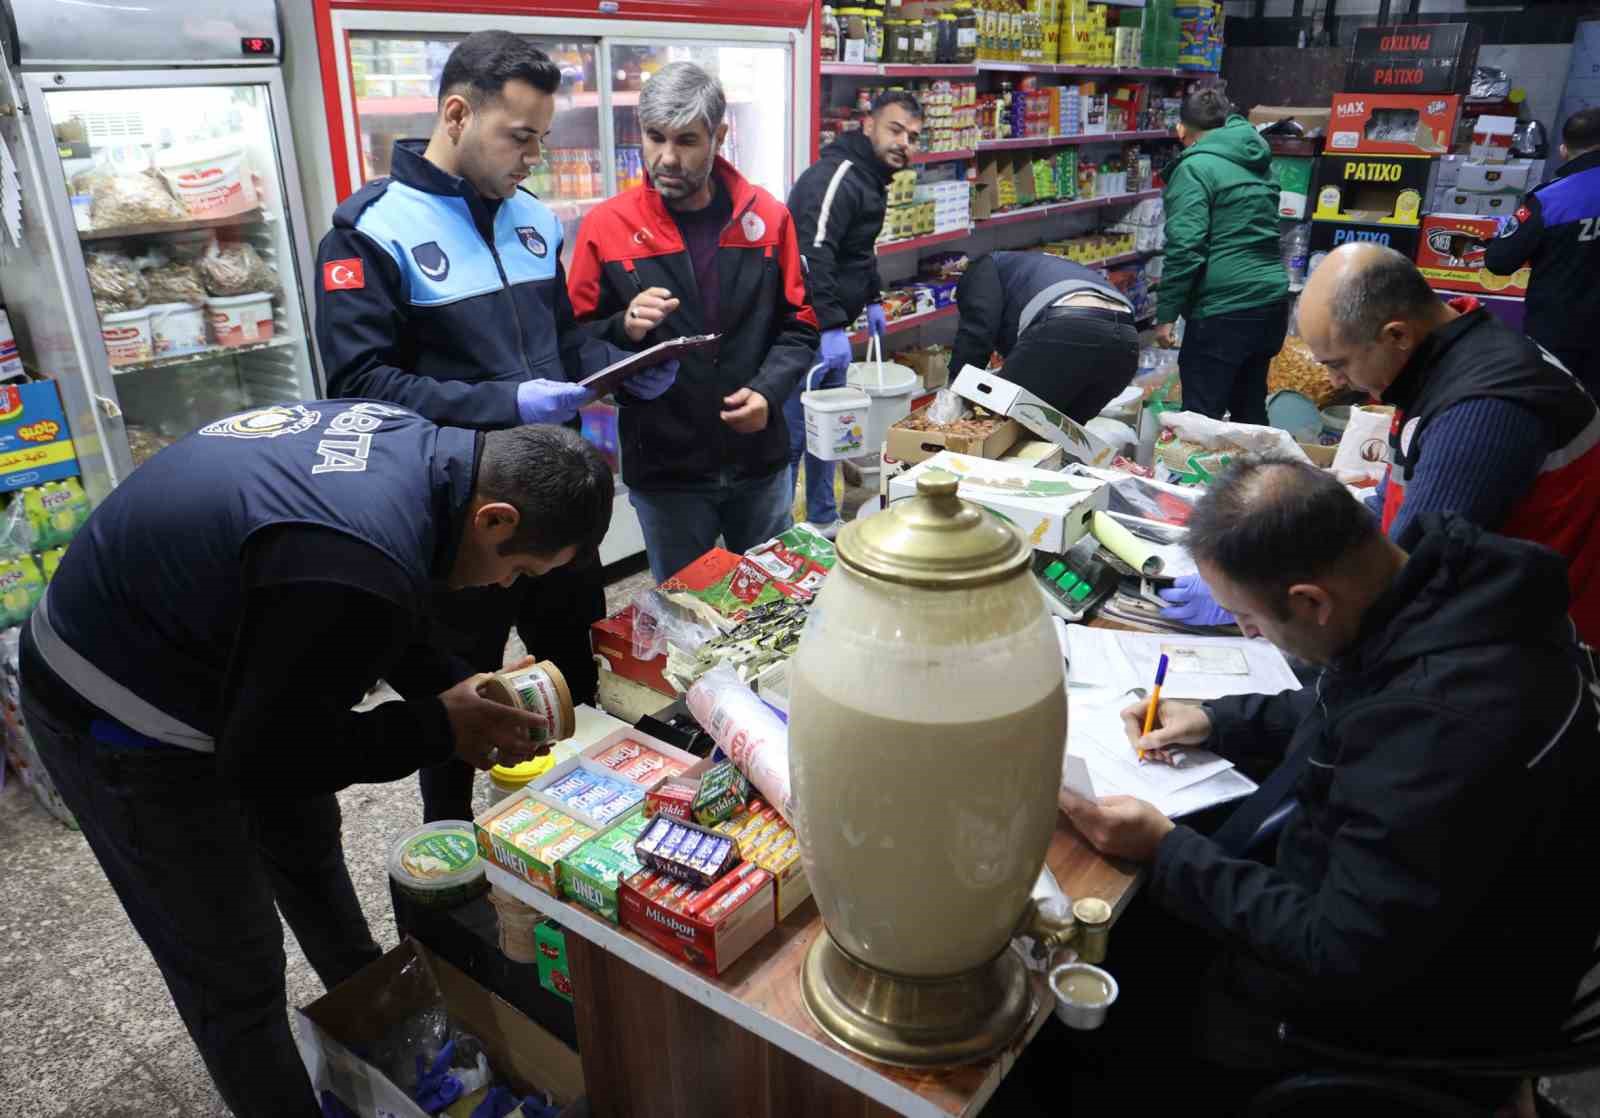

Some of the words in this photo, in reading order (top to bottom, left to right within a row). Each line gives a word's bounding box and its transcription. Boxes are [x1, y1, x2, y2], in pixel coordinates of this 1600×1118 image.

[1374, 67, 1424, 85] PATIXO
[1337, 101, 1365, 114] MAX
[1344, 162, 1402, 181] PATIXO
